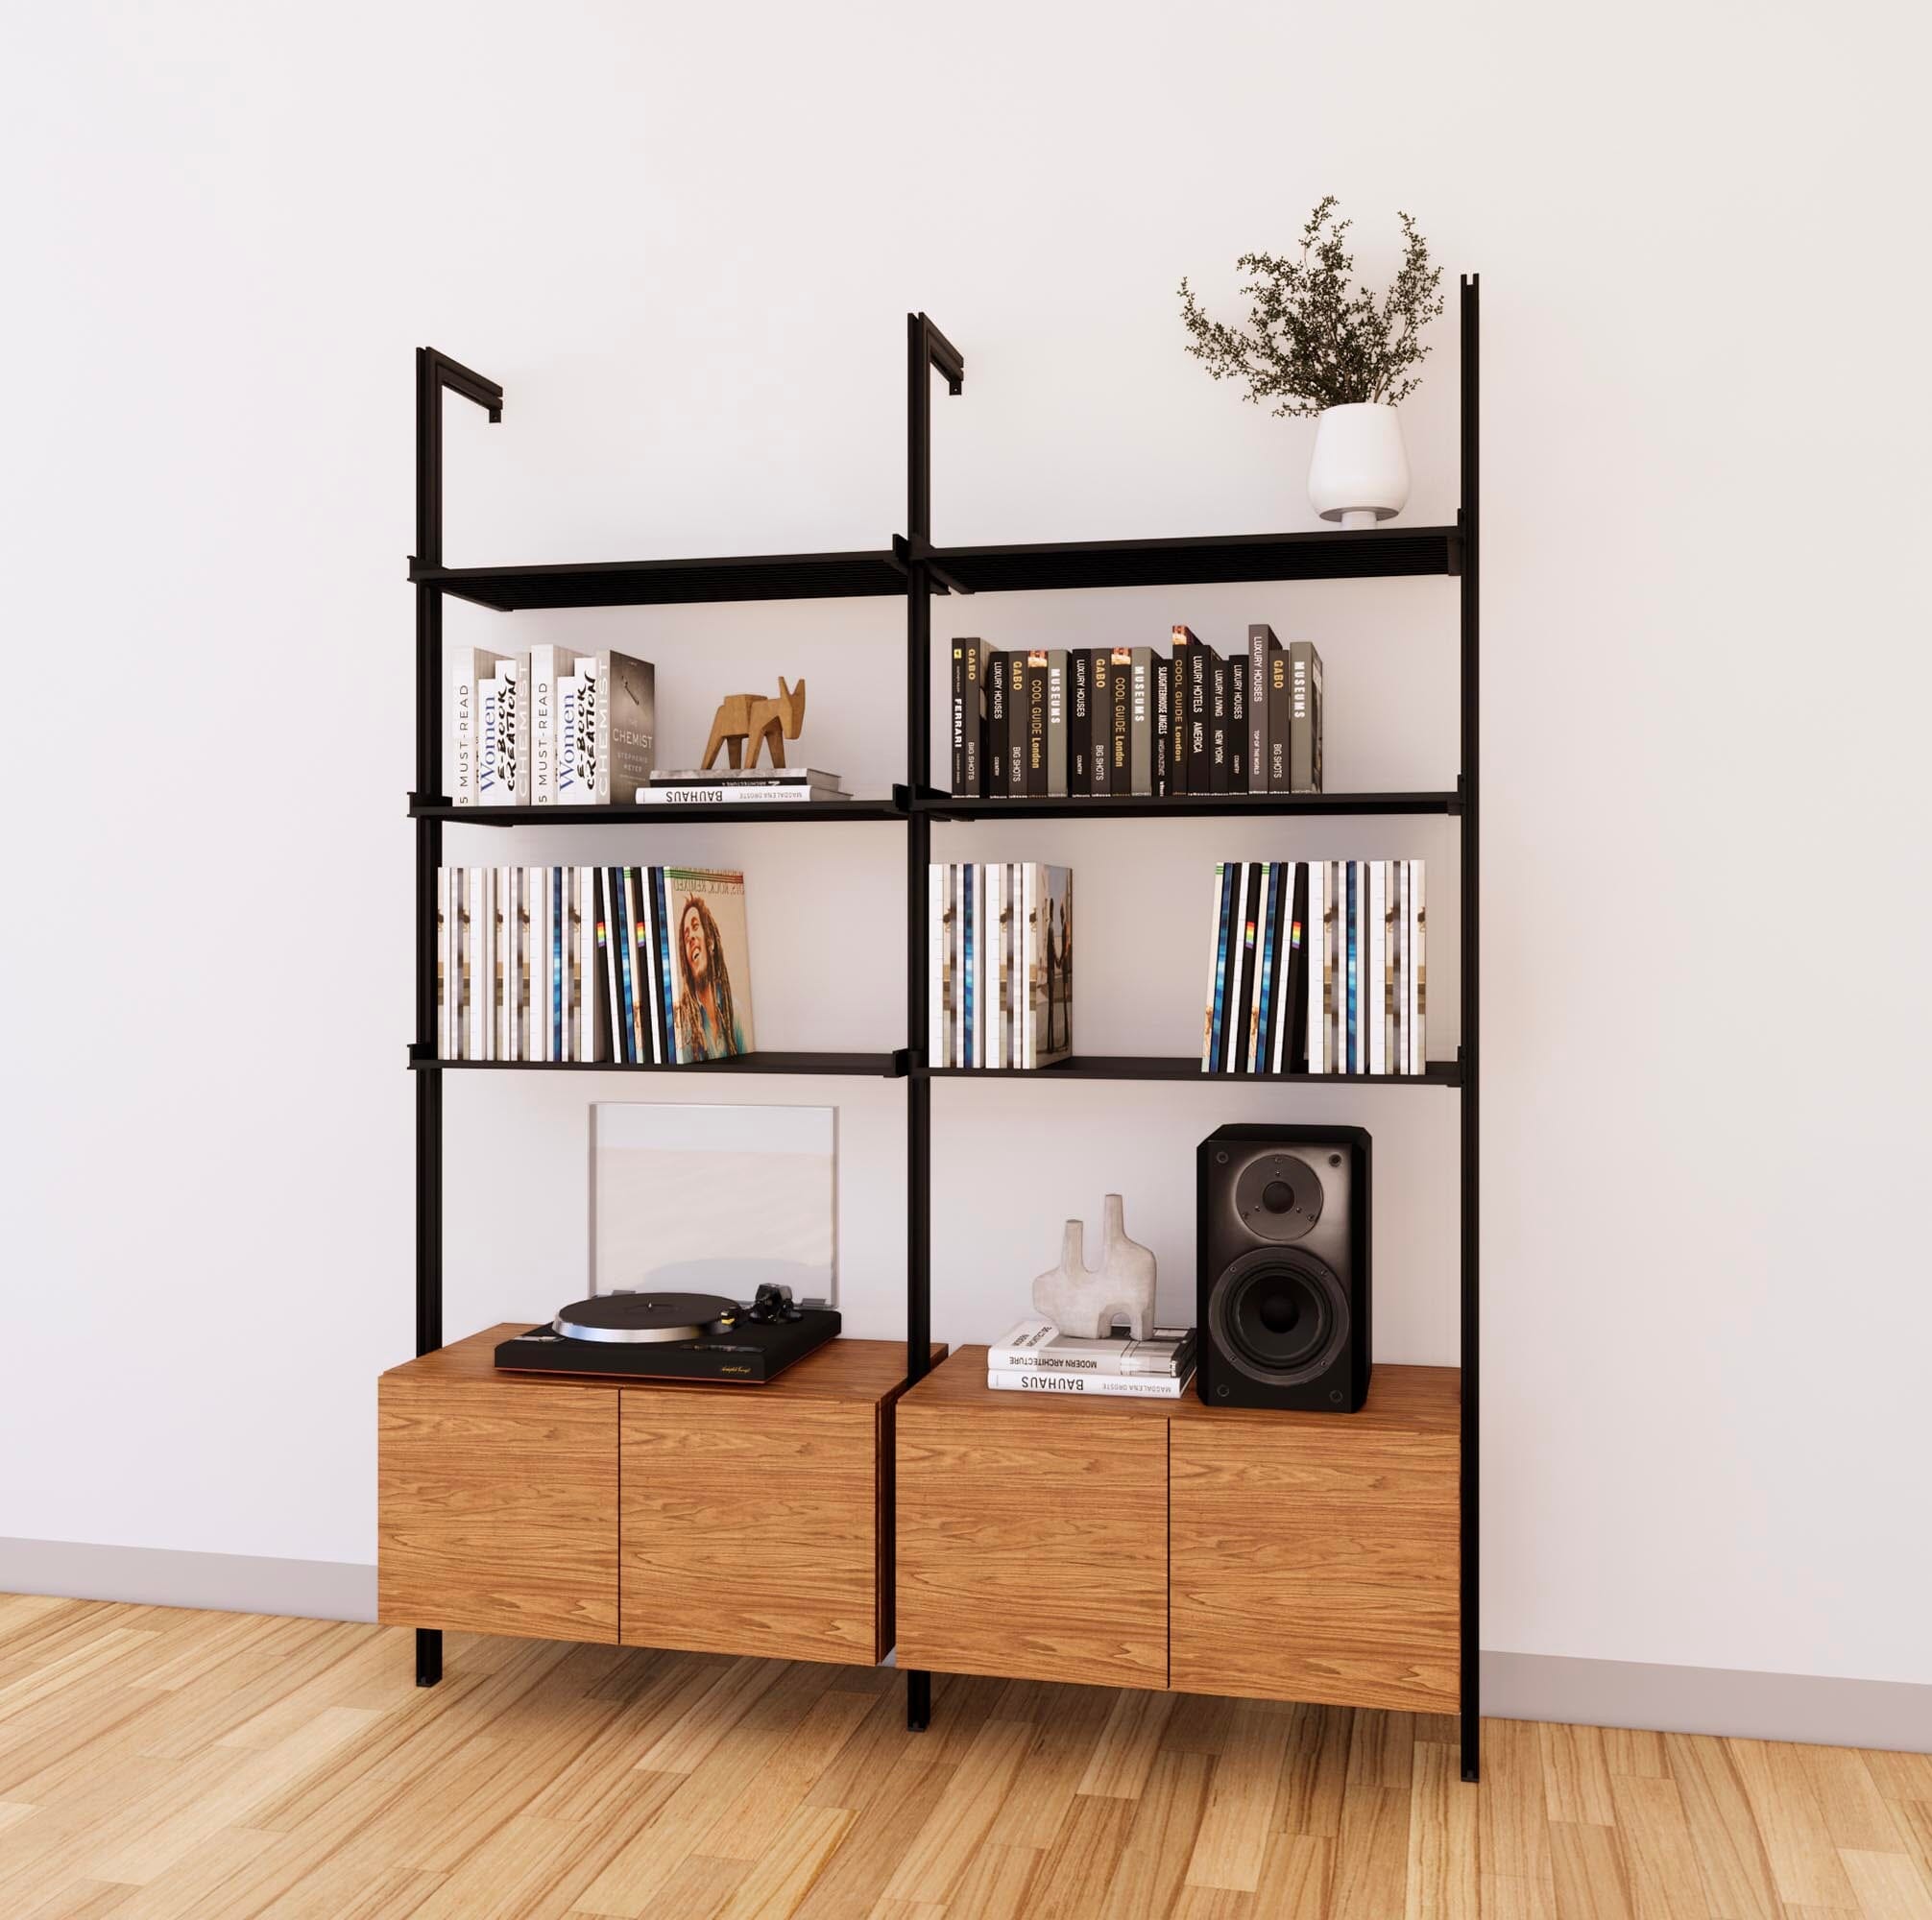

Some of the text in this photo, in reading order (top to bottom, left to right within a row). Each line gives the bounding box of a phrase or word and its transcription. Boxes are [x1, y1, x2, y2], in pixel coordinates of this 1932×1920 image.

[1013, 661, 1022, 690] GABO
[1051, 669, 1060, 723] MUSEUMS
[1097, 659, 1105, 687] GABO
[1135, 666, 1144, 722] MUSEUMS
[1274, 660, 1283, 687] GABO
[1294, 661, 1305, 718] MUSEUMS
[481, 697, 495, 791] Women
[497, 686, 506, 780] E-BOOK
[505, 674, 516, 791] CREATION
[559, 693, 574, 790] Women
[577, 684, 586, 779] E-BOOK
[586, 671, 595, 790] CREATION
[614, 728, 653, 749] CHEMIST
[1032, 680, 1041, 768] COOL GUIDE London
[1116, 678, 1124, 767] COOL GUIDE London
[665, 791, 722, 803] BAUHAUS
[1009, 1356, 1097, 1368] MODERN ARCHITECTURE
[1022, 1377, 1083, 1390] BAUHAUS
[1128, 1384, 1171, 1393] MAGDALENA
